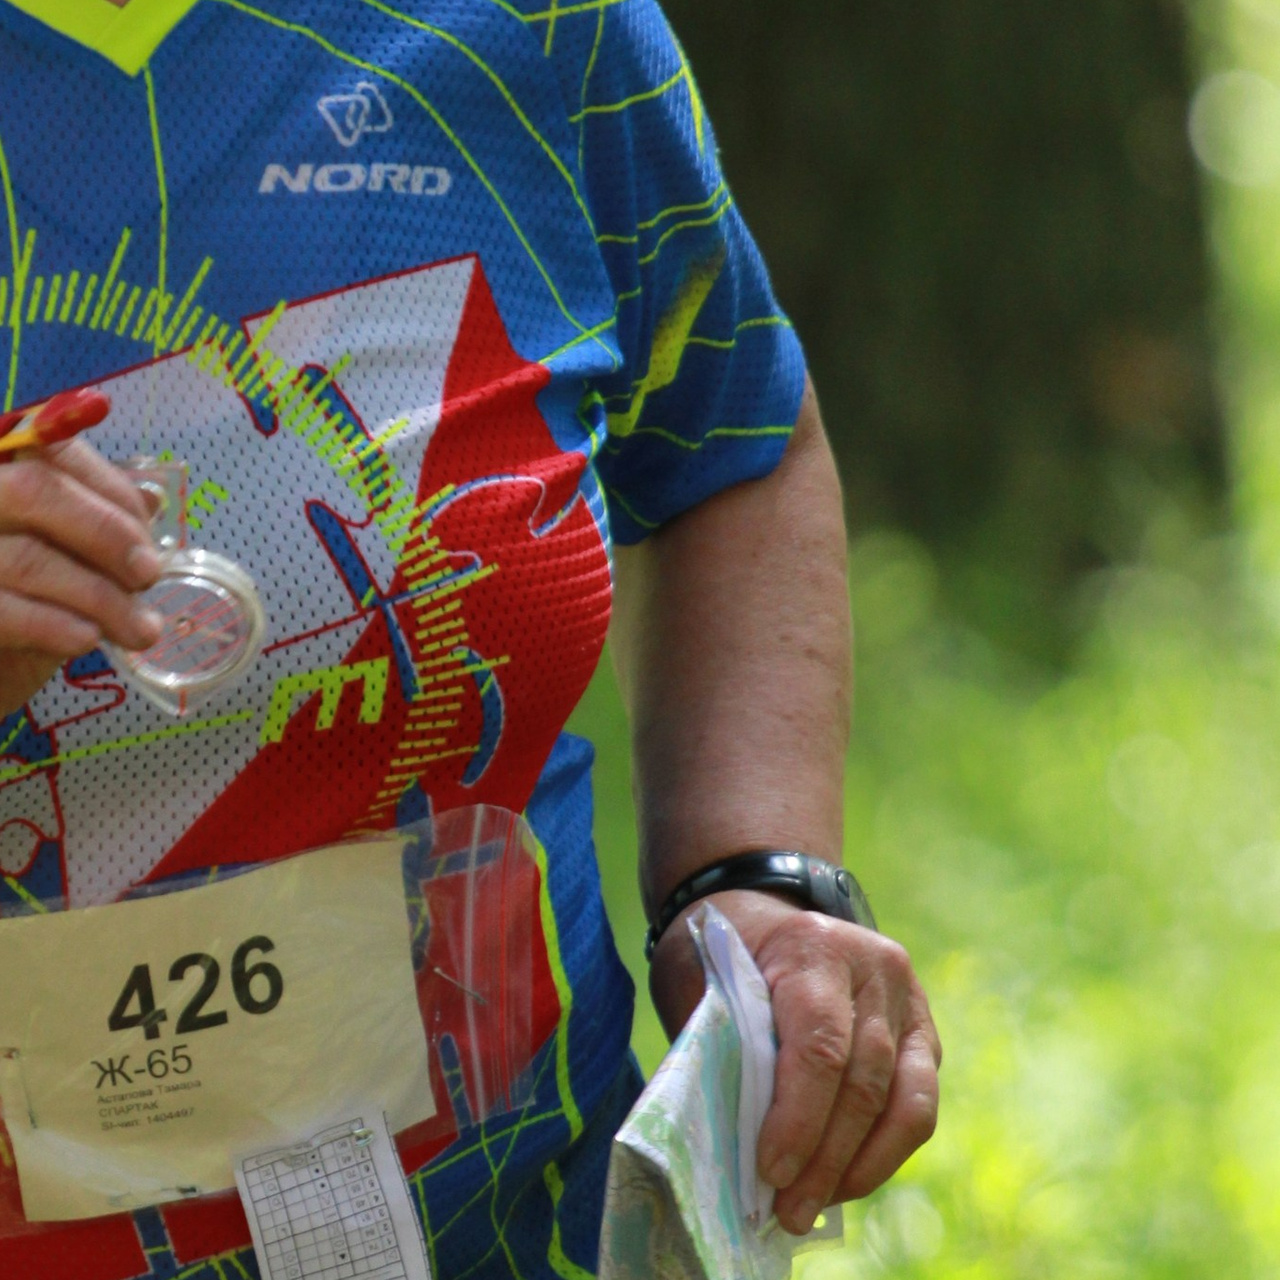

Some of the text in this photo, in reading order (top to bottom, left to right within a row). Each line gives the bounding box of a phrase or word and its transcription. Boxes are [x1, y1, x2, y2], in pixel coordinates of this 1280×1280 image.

[258, 163, 452, 195] NORD
[260, 656, 389, 743] E
[108, 935, 283, 1041] 426
[90, 1044, 193, 1089] Ж-65
[98, 1100, 159, 1118] СПАРТАК
